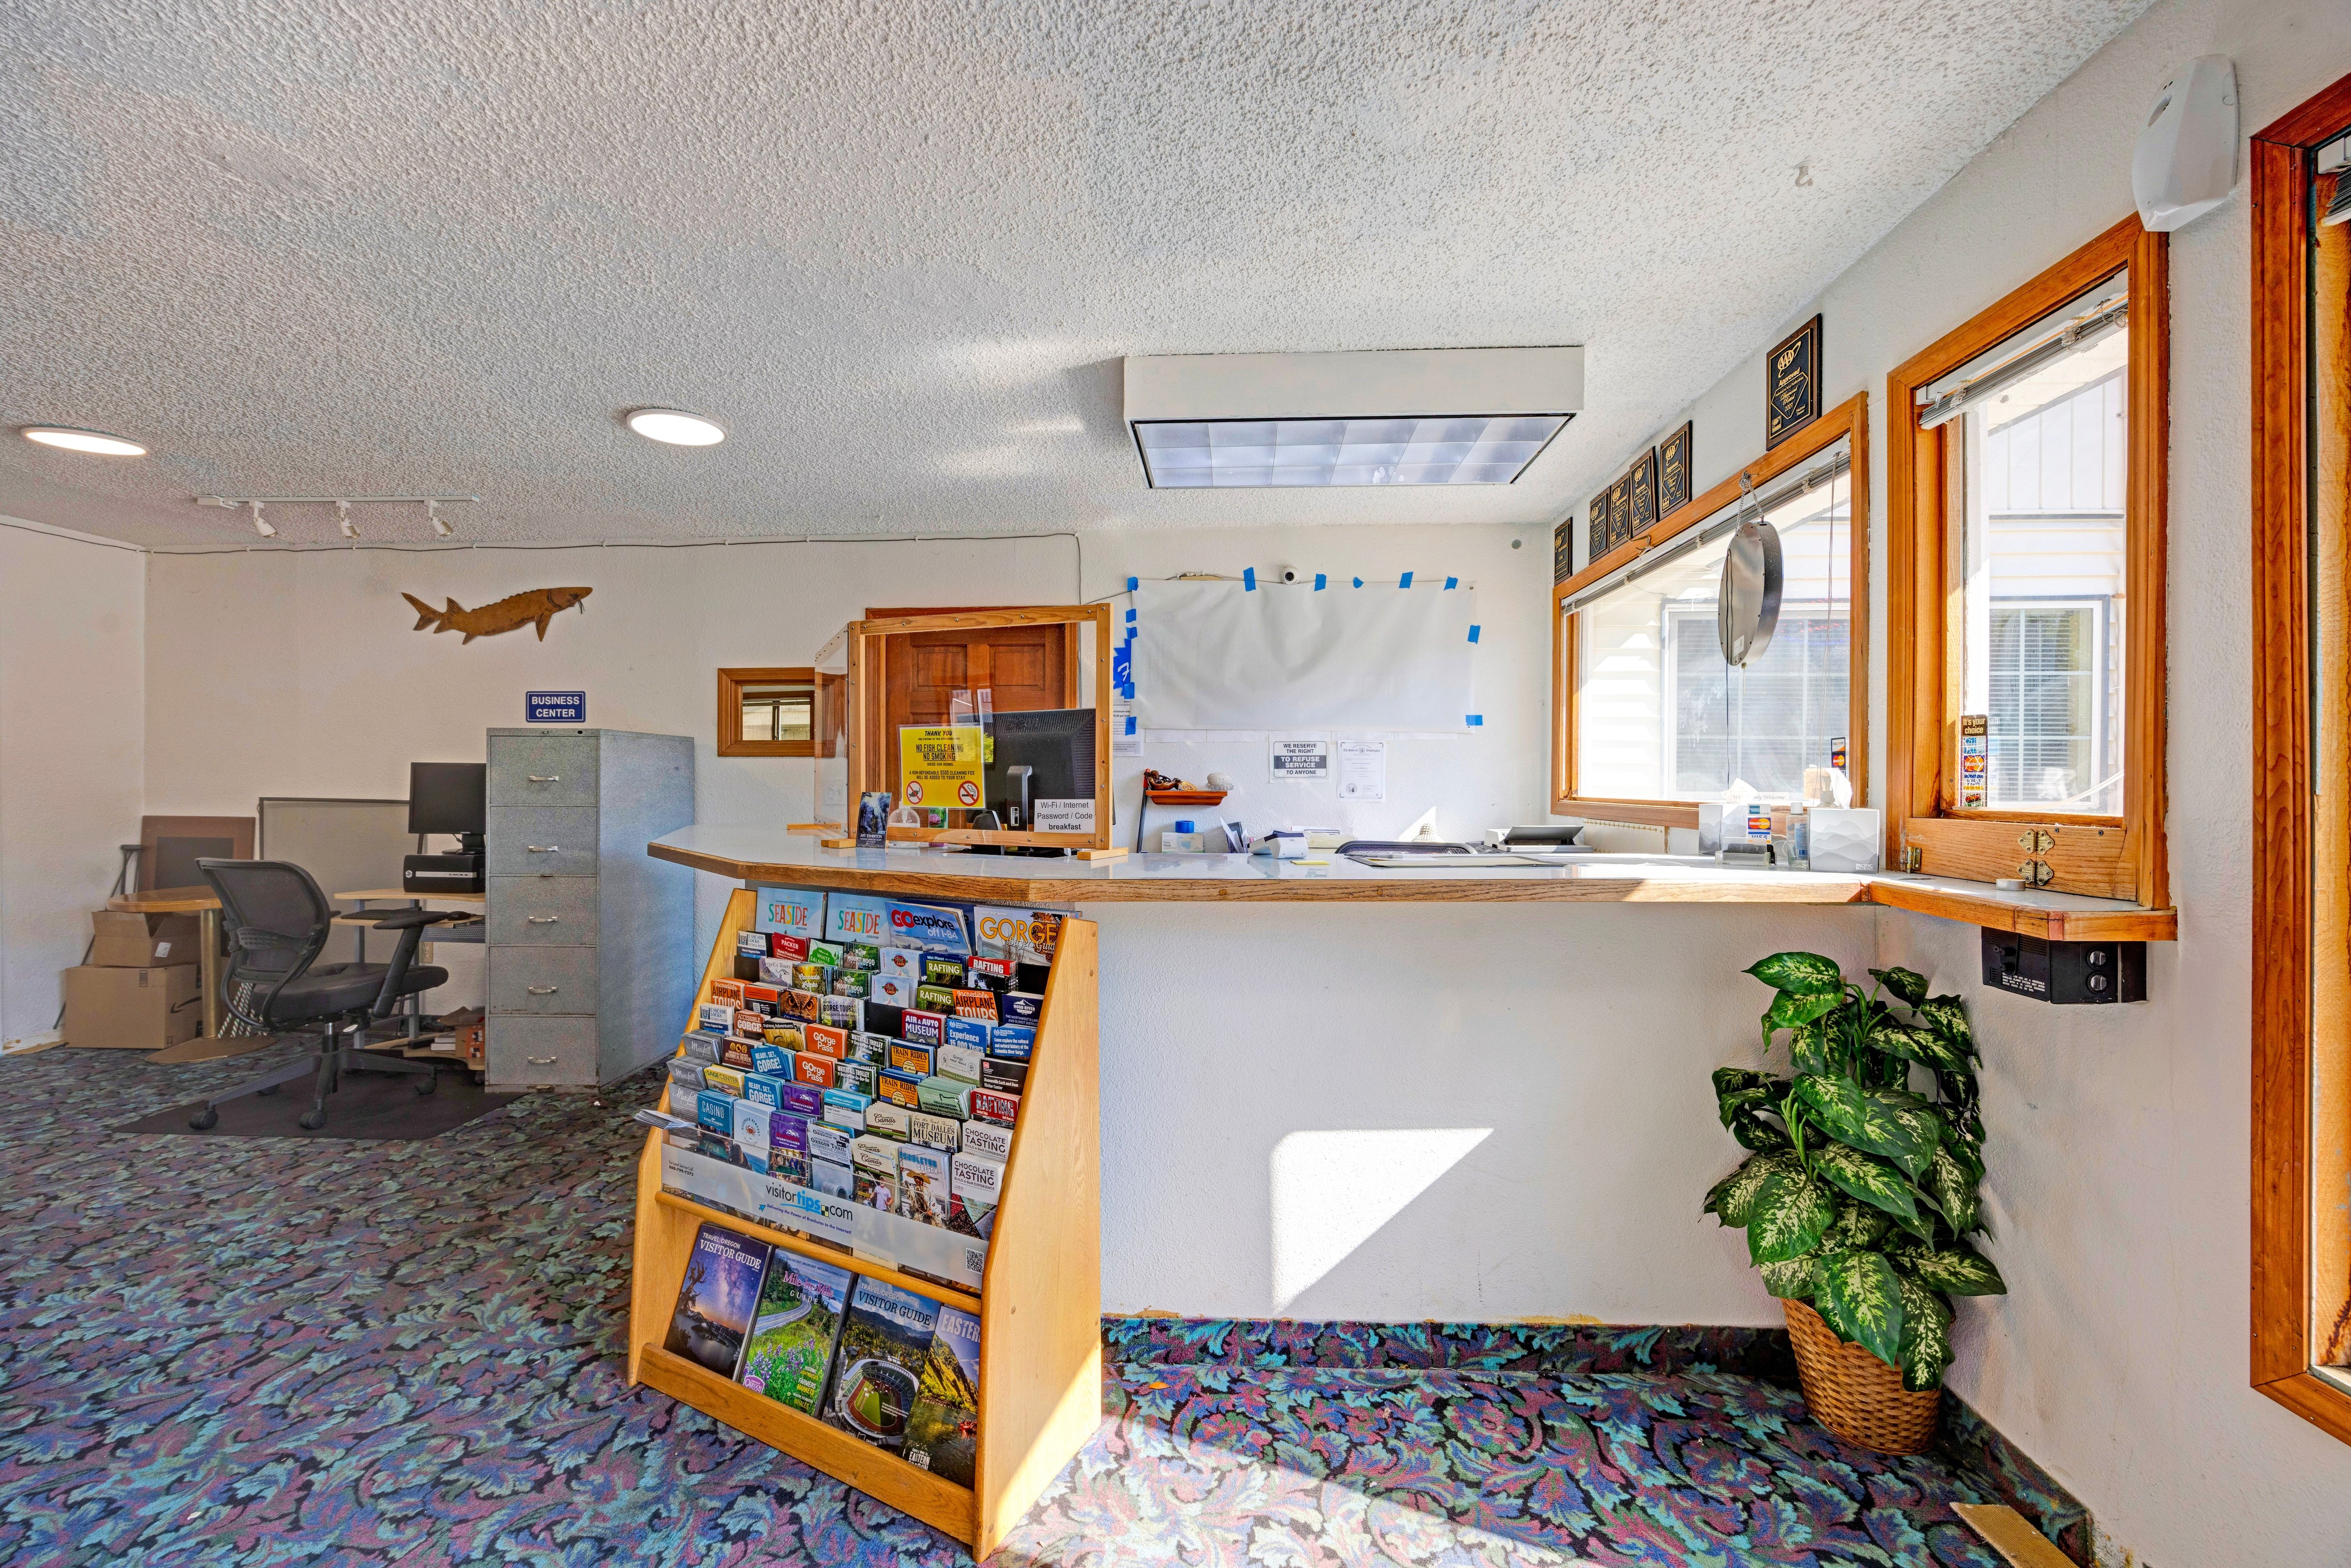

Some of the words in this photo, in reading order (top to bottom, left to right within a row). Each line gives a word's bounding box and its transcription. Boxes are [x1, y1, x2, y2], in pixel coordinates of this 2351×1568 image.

[1779, 350, 1793, 370] AAA
[1778, 367, 1800, 387] Approved
[1784, 402, 1793, 412] 2007
[531, 696, 580, 705] BUSINESS
[1972, 718, 1985, 727] your
[768, 903, 808, 926] SEASIDE
[837, 910, 880, 935] SEASIDE
[928, 928, 939, 937] off
[941, 928, 958, 940] I-84
[980, 917, 1057, 944] GORGE
[781, 940, 799, 949] PACKER
[817, 953, 830, 962] WHITE
[863, 957, 875, 966] HOOD
[929, 963, 960, 974] RAFTING
[973, 959, 1004, 974] RAFTING
[712, 985, 741, 1001] AIRPLANE
[714, 982, 737, 991] Incredible
[920, 990, 952, 1004] RAFTING
[956, 995, 995, 1009] AIRPLANE
[738, 1014, 761, 1023] ACCESSIBLE
[737, 1021, 762, 1032] GORGE
[906, 1023, 939, 1037] MUSEUM
[813, 1032, 836, 1047] GOrge
[851, 1033, 869, 1043] WATERFALL
[869, 1038, 884, 1048] TROLLEY
[950, 1030, 979, 1042] Experience
[817, 1041, 834, 1053] Pass
[893, 1047, 908, 1057] TRAIN
[910, 1051, 927, 1060] RIDES
[757, 1057, 782, 1072] GORGE!
[837, 1065, 855, 1075] WATERFALL
[855, 1070, 869, 1078] TROLLEY
[719, 1074, 738, 1084] CENTER
[806, 1071, 823, 1083] Pass
[881, 1077, 898, 1088] TRAIN
[899, 1082, 916, 1093] RIDES
[749, 1089, 775, 1105] GORGE!
[702, 1101, 724, 1119] CASINO
[976, 1093, 1014, 1117] RAFTING
[874, 1113, 896, 1123] Camas
[914, 1120, 929, 1129] FORT
[931, 1124, 955, 1135] DALLES
[913, 1127, 955, 1146] MUSEUM
[965, 1128, 1005, 1144] CHOCOLATE
[811, 1137, 830, 1147] OREGON
[830, 1143, 845, 1152] TRAIL
[965, 1135, 1005, 1153] TASTING
[860, 1153, 883, 1166] Camas
[669, 1166, 694, 1176] 800-799-7373
[917, 1164, 938, 1174] OREGON
[955, 1161, 994, 1176] CHOCOLATE
[955, 1167, 994, 1185] TASTING
[767, 1204, 784, 1213] Delivering
[807, 1217, 824, 1226] Brochures
[836, 1226, 852, 1235] Internet!
[703, 1232, 720, 1243] TRAVEL
[721, 1238, 741, 1250] OREGON
[700, 1239, 735, 1260] VISITOR
[735, 1252, 762, 1270] GUIDE
[789, 1290, 819, 1305] GUIDE
[861, 1283, 880, 1295] TRAVEL
[881, 1290, 904, 1303] OREGON
[859, 1291, 898, 1314] VISITOR
[899, 1305, 932, 1326] GUIDE
[797, 1384, 815, 1395] MARKETS
[798, 1378, 816, 1389] FARMERS
[794, 1398, 810, 1409] WHALES
[908, 1451, 931, 1465] EASTERN
